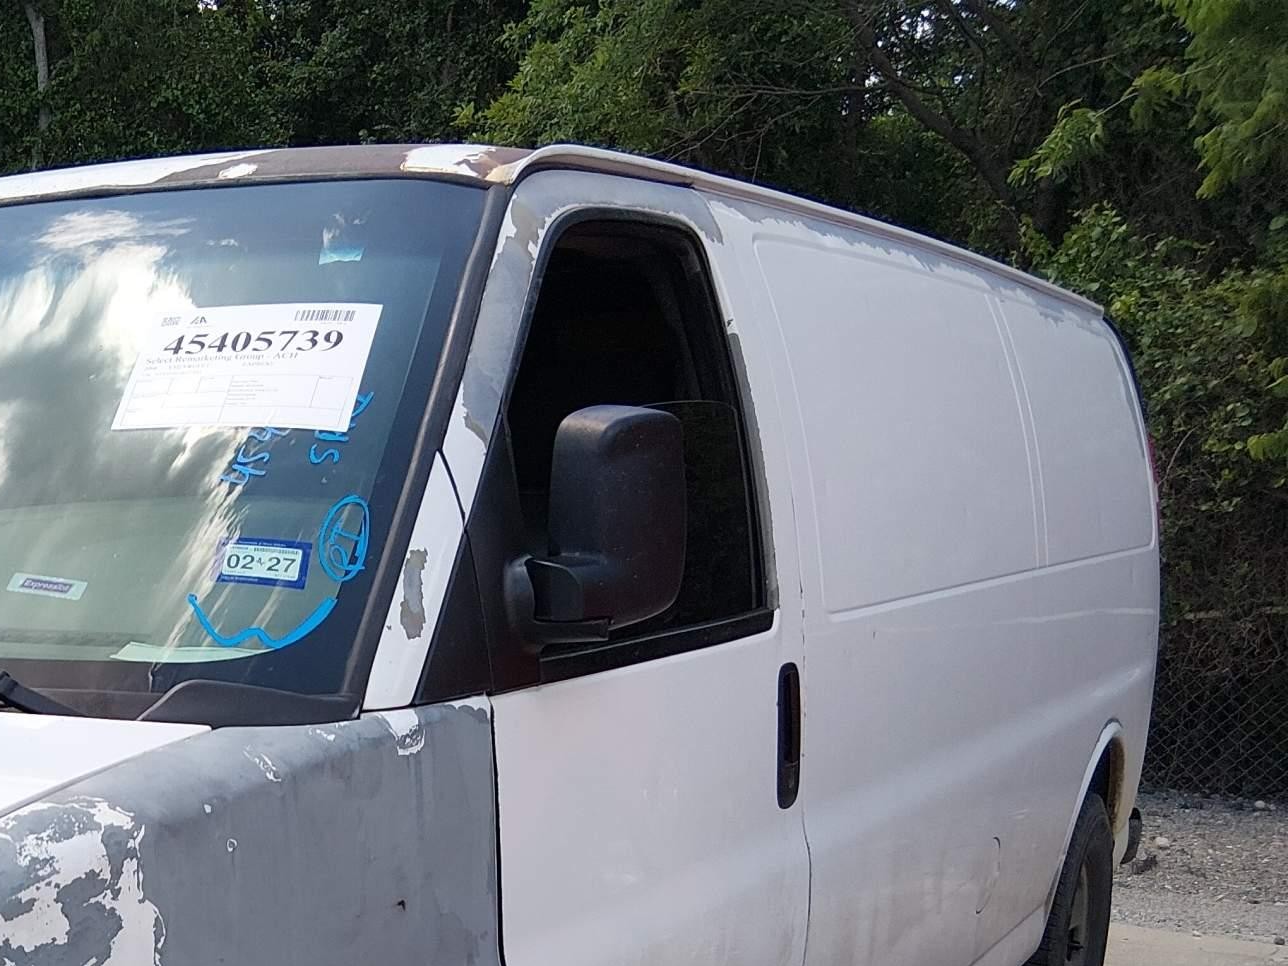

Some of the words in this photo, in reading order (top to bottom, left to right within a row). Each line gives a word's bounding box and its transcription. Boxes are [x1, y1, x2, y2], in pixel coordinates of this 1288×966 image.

[163, 330, 344, 355] 45405739
[175, 354, 233, 363] Remarketing
[235, 352, 265, 361] Group
[226, 554, 255, 570] 02
[266, 556, 296, 573] 27
